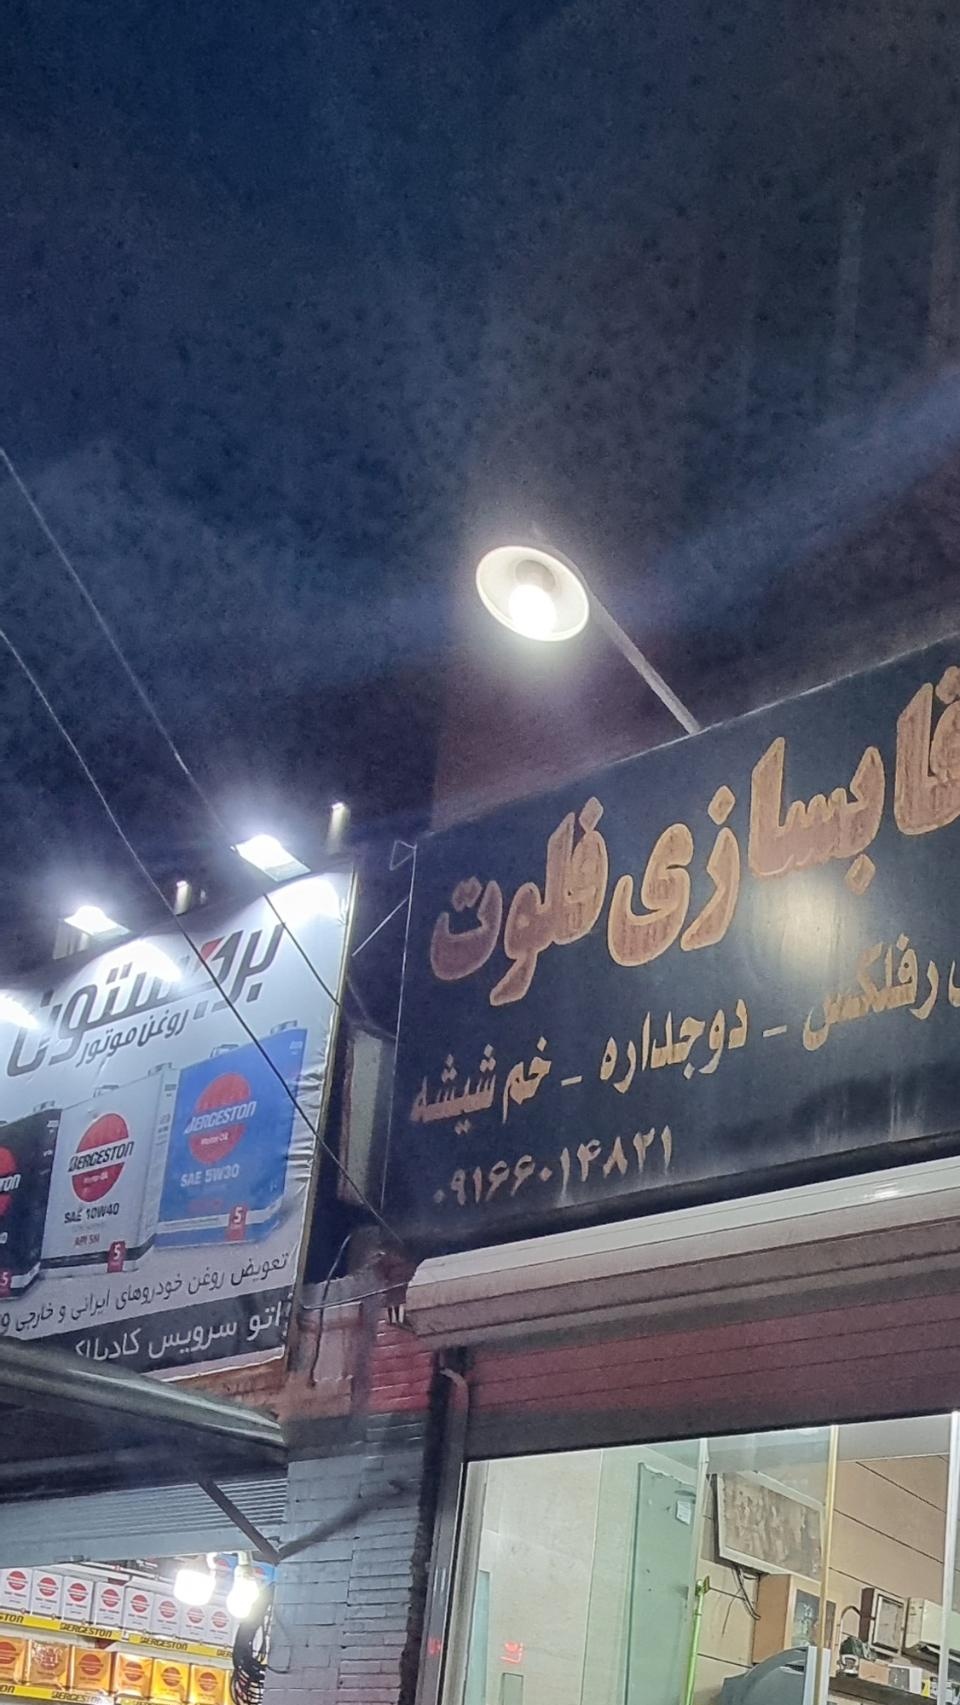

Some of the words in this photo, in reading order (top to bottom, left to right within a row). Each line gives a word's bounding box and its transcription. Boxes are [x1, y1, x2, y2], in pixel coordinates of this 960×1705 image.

[431, 797, 608, 1006] فلوت
[803, 934, 939, 1050] رفلکس
[76, 1027, 137, 1067] موتور
[137, 1009, 189, 1047] روغن
[409, 1043, 497, 1134] شیشه
[503, 1036, 552, 1124] خم
[180, 1171, 200, 1187] SAE
[205, 1163, 240, 1183] 5W30
[64, 1208, 82, 1224] SAE
[86, 1202, 120, 1220] 10W40
[234, 1206, 242, 1223] 5
[113, 1244, 121, 1260] 5
[230, 1253, 289, 1285] تعویض
[116, 1272, 183, 1310] خودروهای
[188, 1267, 225, 1294] روغن
[16, 1302, 54, 1331] خارجی
[71, 1289, 110, 1320] ایرانی
[247, 1302, 282, 1341] اتو
[149, 1320, 238, 1359] سرویس
